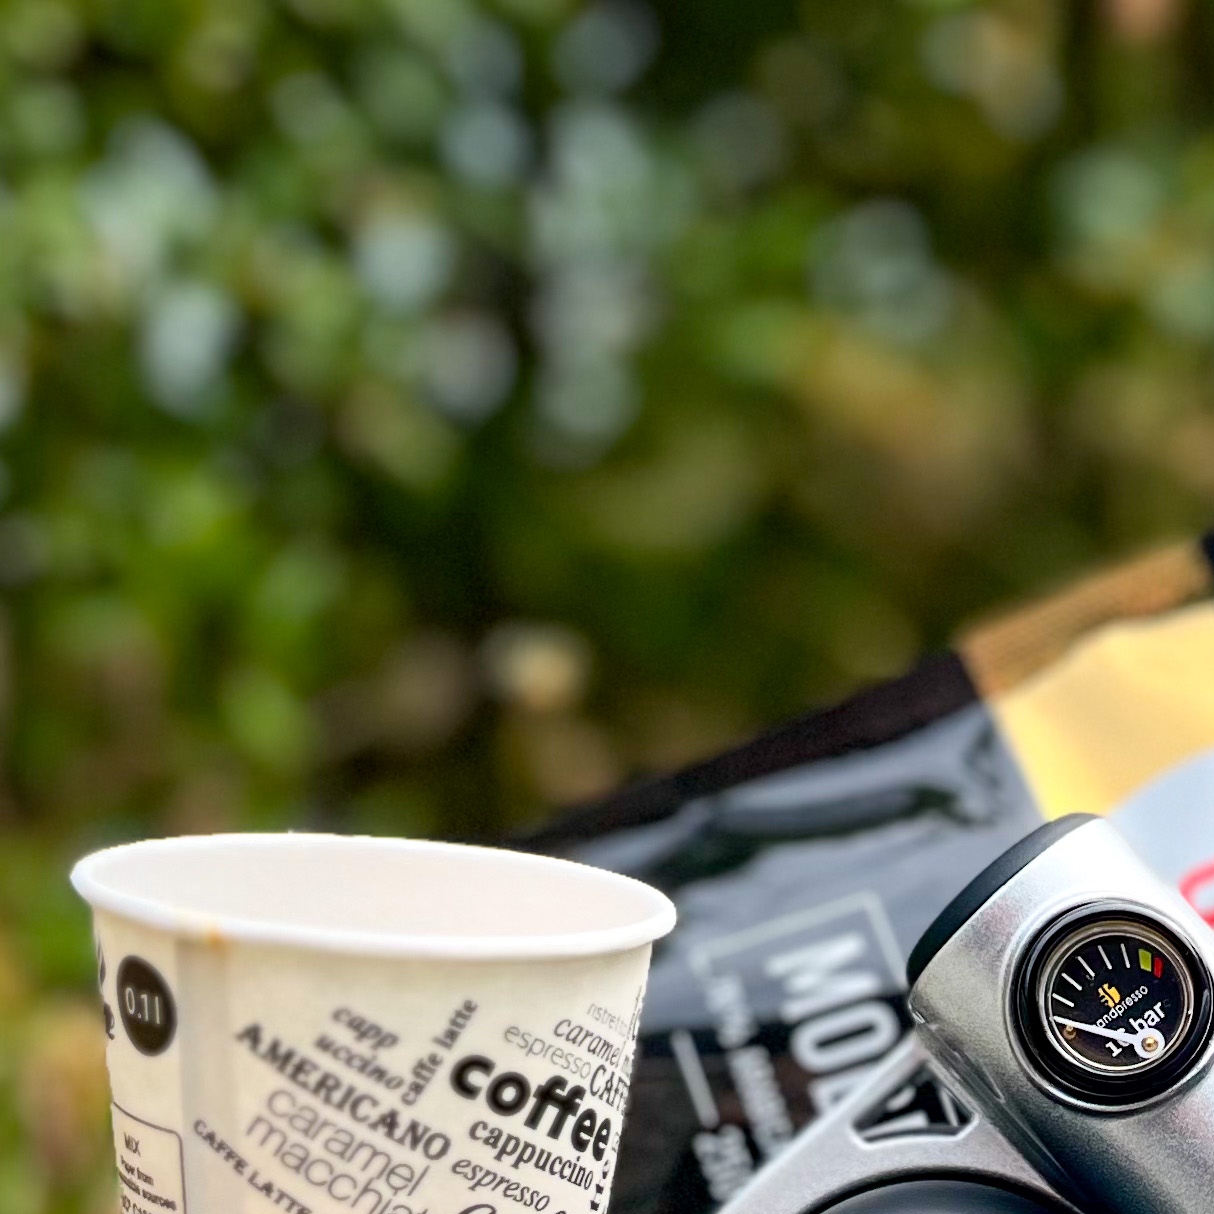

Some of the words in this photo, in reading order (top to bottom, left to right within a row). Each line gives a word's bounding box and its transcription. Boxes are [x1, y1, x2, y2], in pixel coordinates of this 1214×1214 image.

[331, 1006, 399, 1051] capp
[1095, 985, 1149, 1028] andpresso
[1128, 1002, 1165, 1032] bar
[313, 1034, 405, 1090] uccino
[504, 1026, 592, 1079] espresso
[553, 1019, 628, 1069] caramel
[234, 1022, 452, 1161] AMERICANO
[450, 1054, 612, 1161] coffee
[193, 1119, 249, 1176] CAFFE
[266, 1089, 431, 1197] caramel
[469, 1121, 594, 1190] cappuccino
[451, 1159, 550, 1211] espresso
